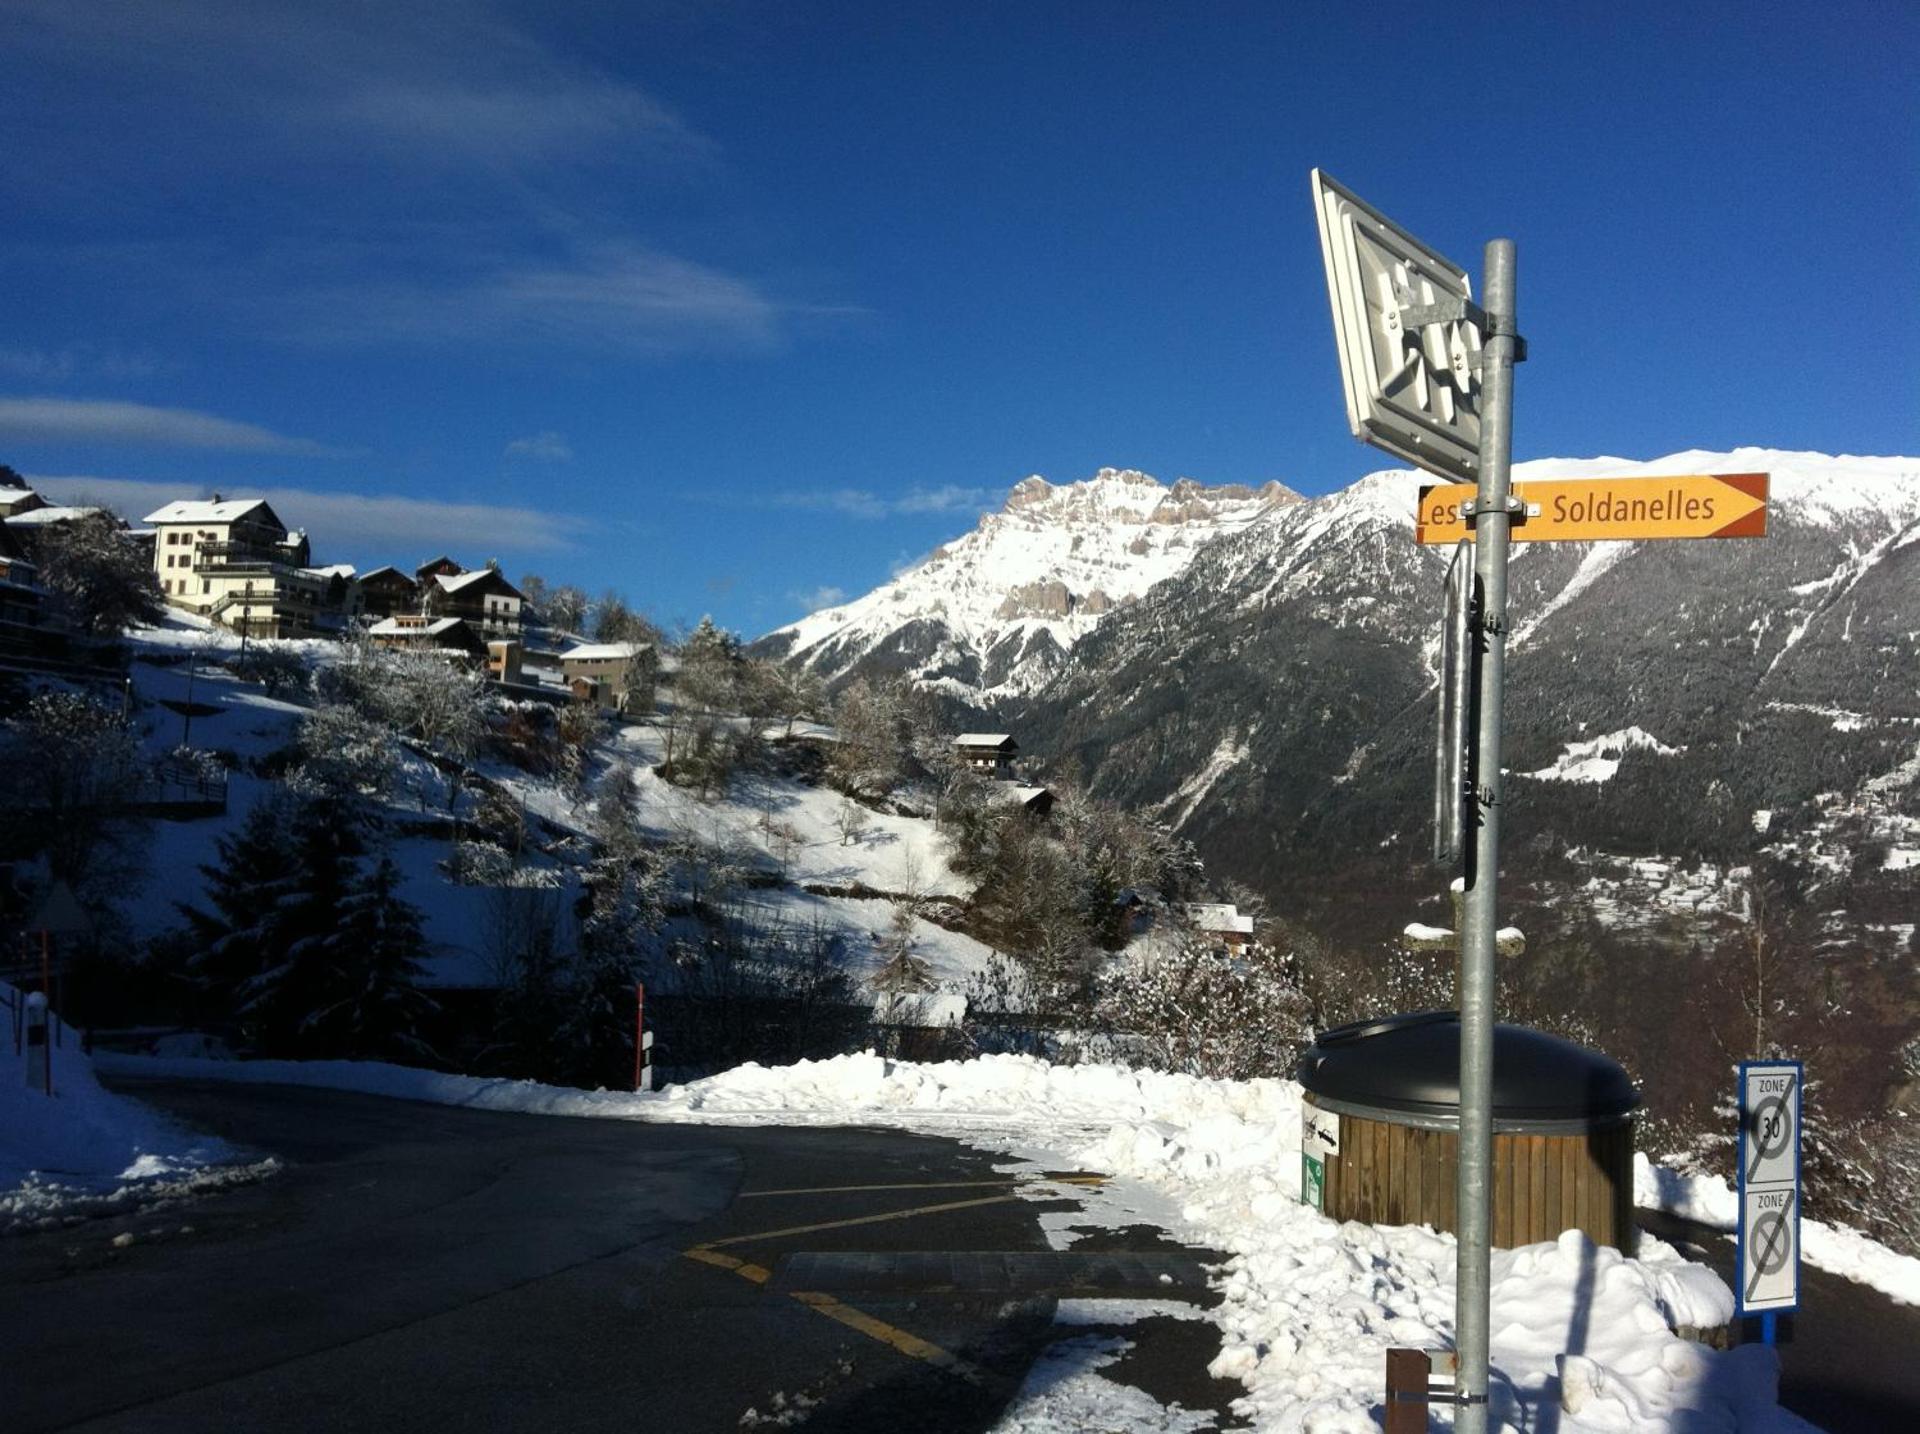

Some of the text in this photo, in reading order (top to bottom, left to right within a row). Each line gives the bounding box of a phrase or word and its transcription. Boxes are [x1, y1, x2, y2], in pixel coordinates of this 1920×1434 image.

[1418, 489, 1715, 526] Les Soldanelles
[1759, 1079, 1785, 1093] ZONE
[1763, 1117, 1780, 1139] 30
[1758, 1194, 1784, 1208] ZONE
